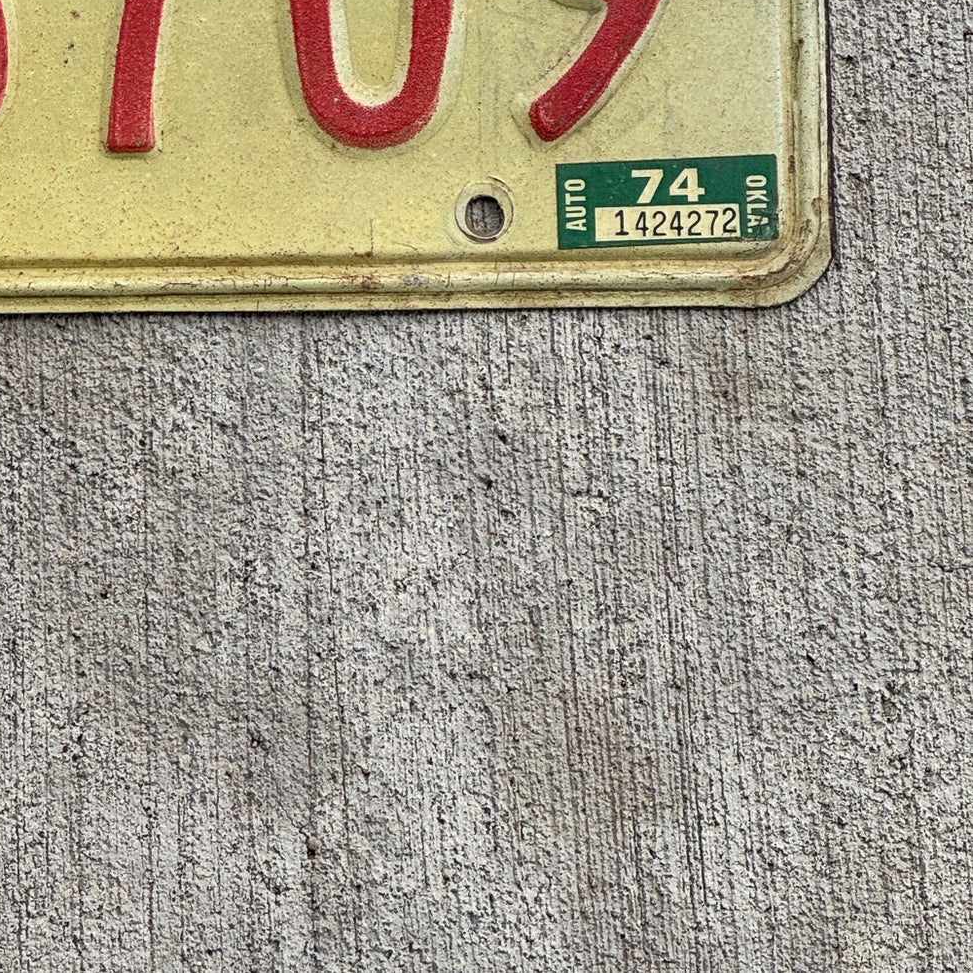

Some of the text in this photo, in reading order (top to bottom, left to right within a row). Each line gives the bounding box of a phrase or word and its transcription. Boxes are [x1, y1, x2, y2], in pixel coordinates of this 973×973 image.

[630, 167, 706, 204] 74
[564, 178, 587, 232] AUTO
[614, 207, 738, 237] 1424272
